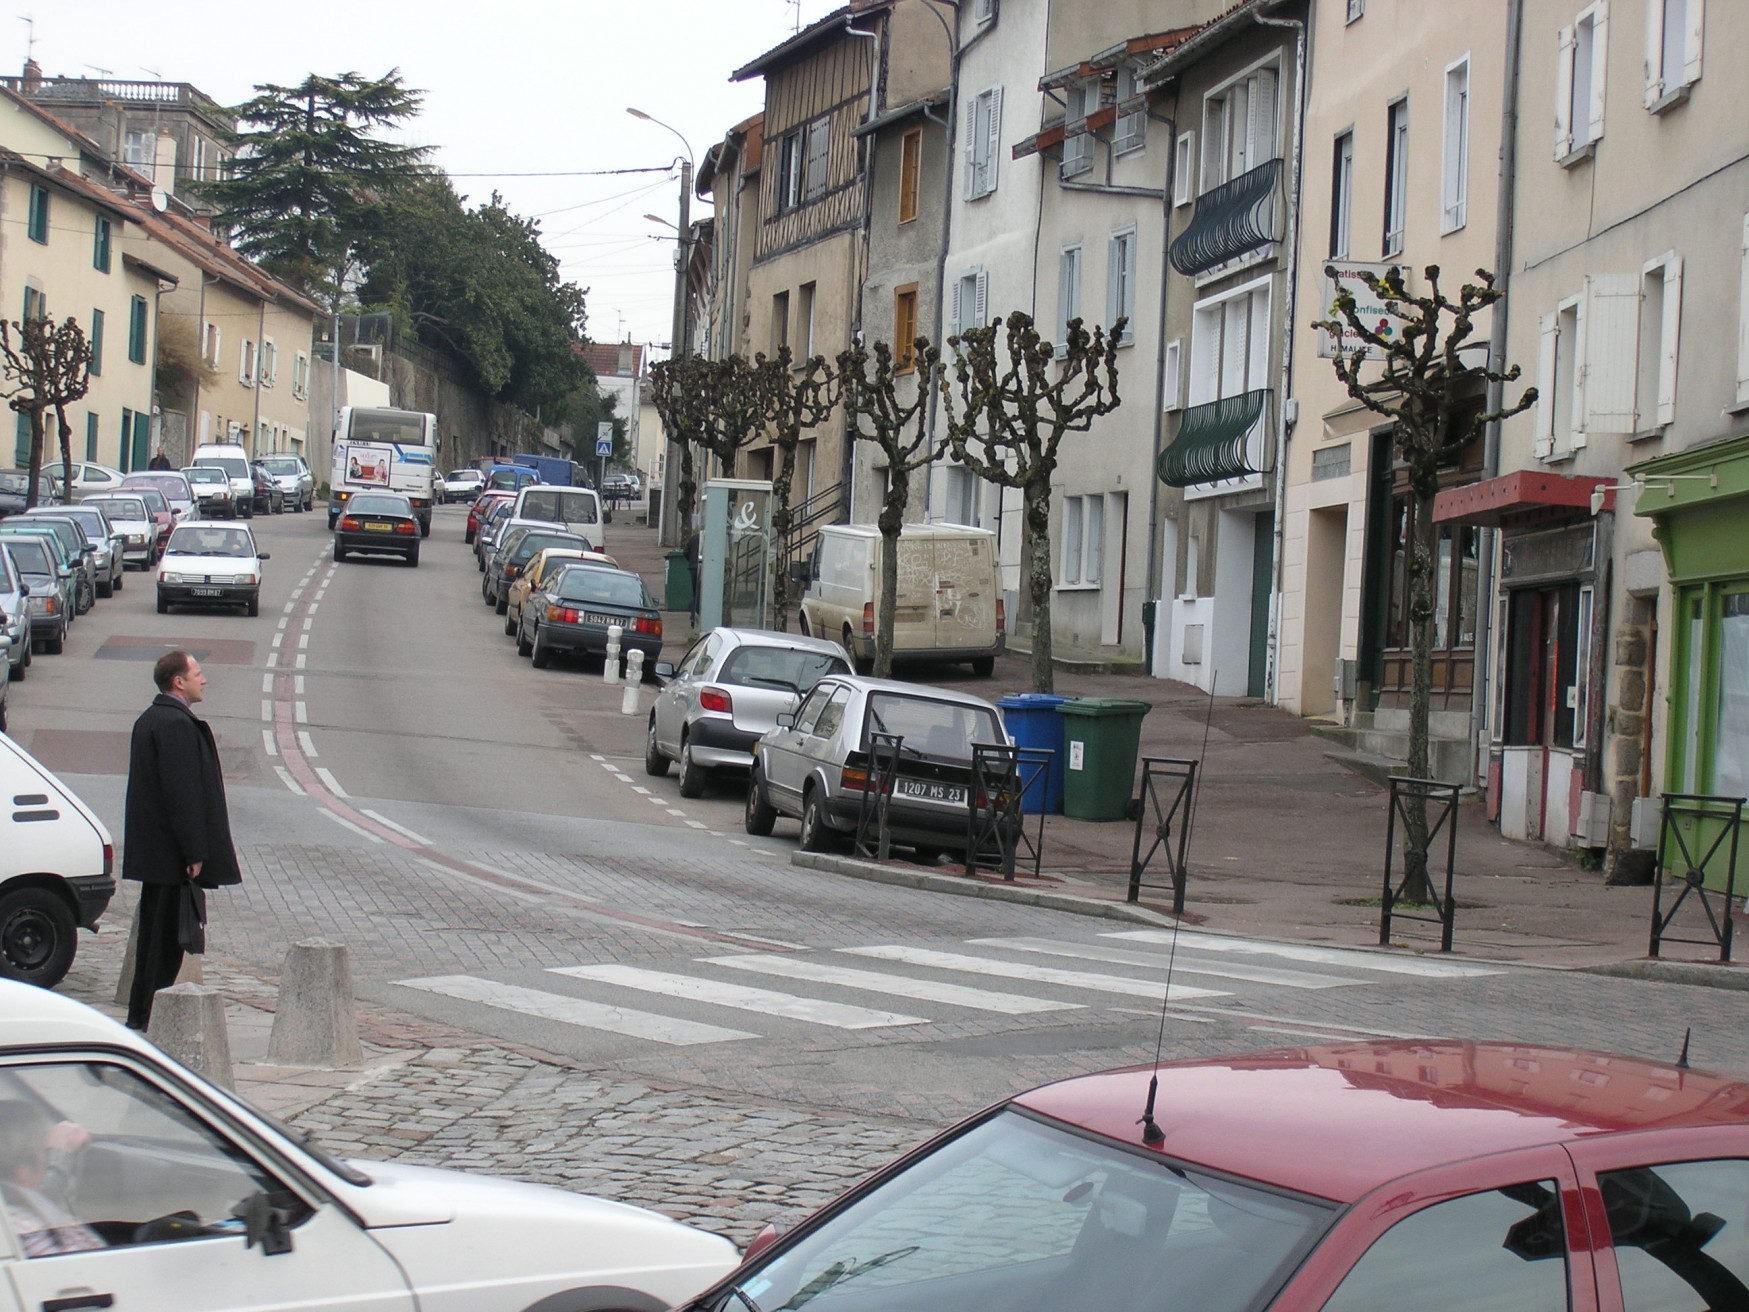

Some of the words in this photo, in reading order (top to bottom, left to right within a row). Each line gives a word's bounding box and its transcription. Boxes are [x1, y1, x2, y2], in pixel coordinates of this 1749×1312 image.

[904, 782, 926, 795] 1207
[930, 785, 944, 799] MS
[948, 788, 960, 801] 23
